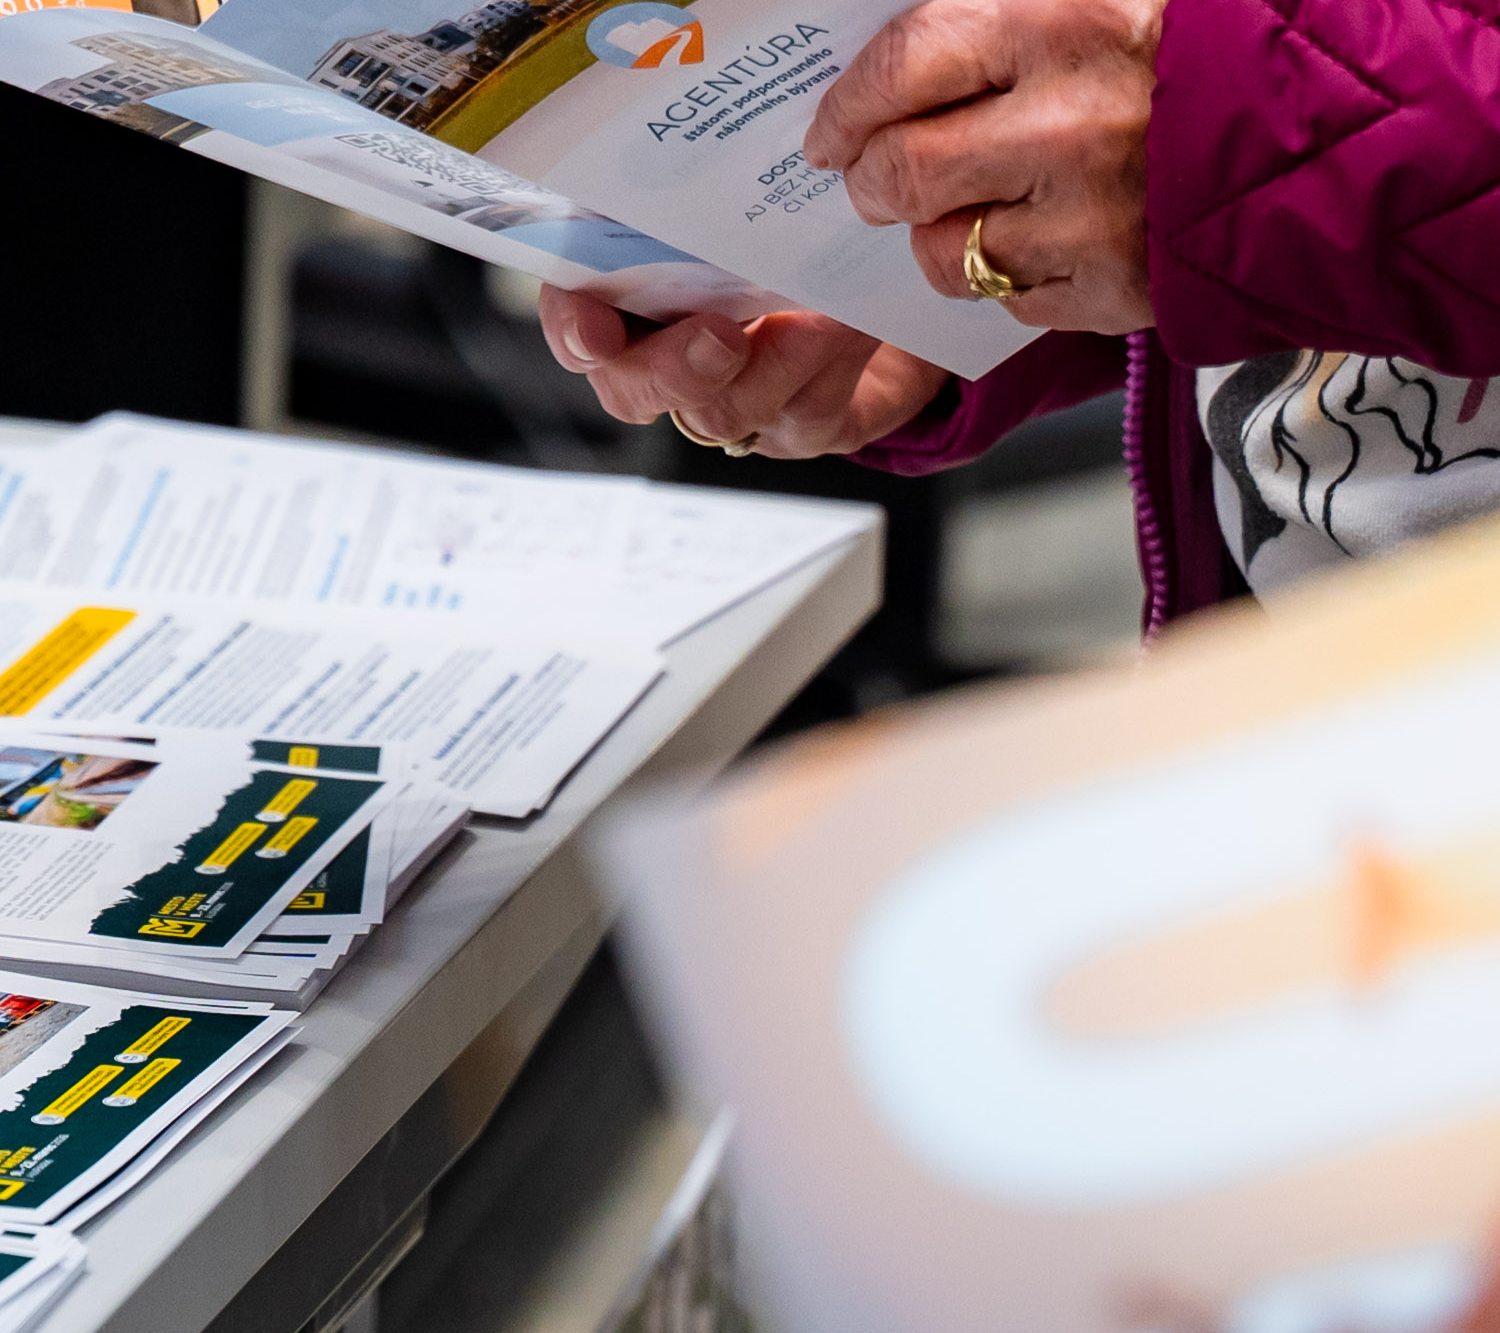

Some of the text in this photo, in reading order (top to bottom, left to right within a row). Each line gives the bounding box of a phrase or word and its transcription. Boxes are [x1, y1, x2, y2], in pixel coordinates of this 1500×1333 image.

[645, 21, 831, 144] AGENTÚRA
[681, 46, 834, 144] štátom podporovaného
[713, 63, 842, 142] nájomného bývania
[757, 149, 806, 185] DOST
[783, 169, 845, 214] ČI KOM
[744, 204, 767, 223] AJ
[763, 178, 802, 205] BEZ
